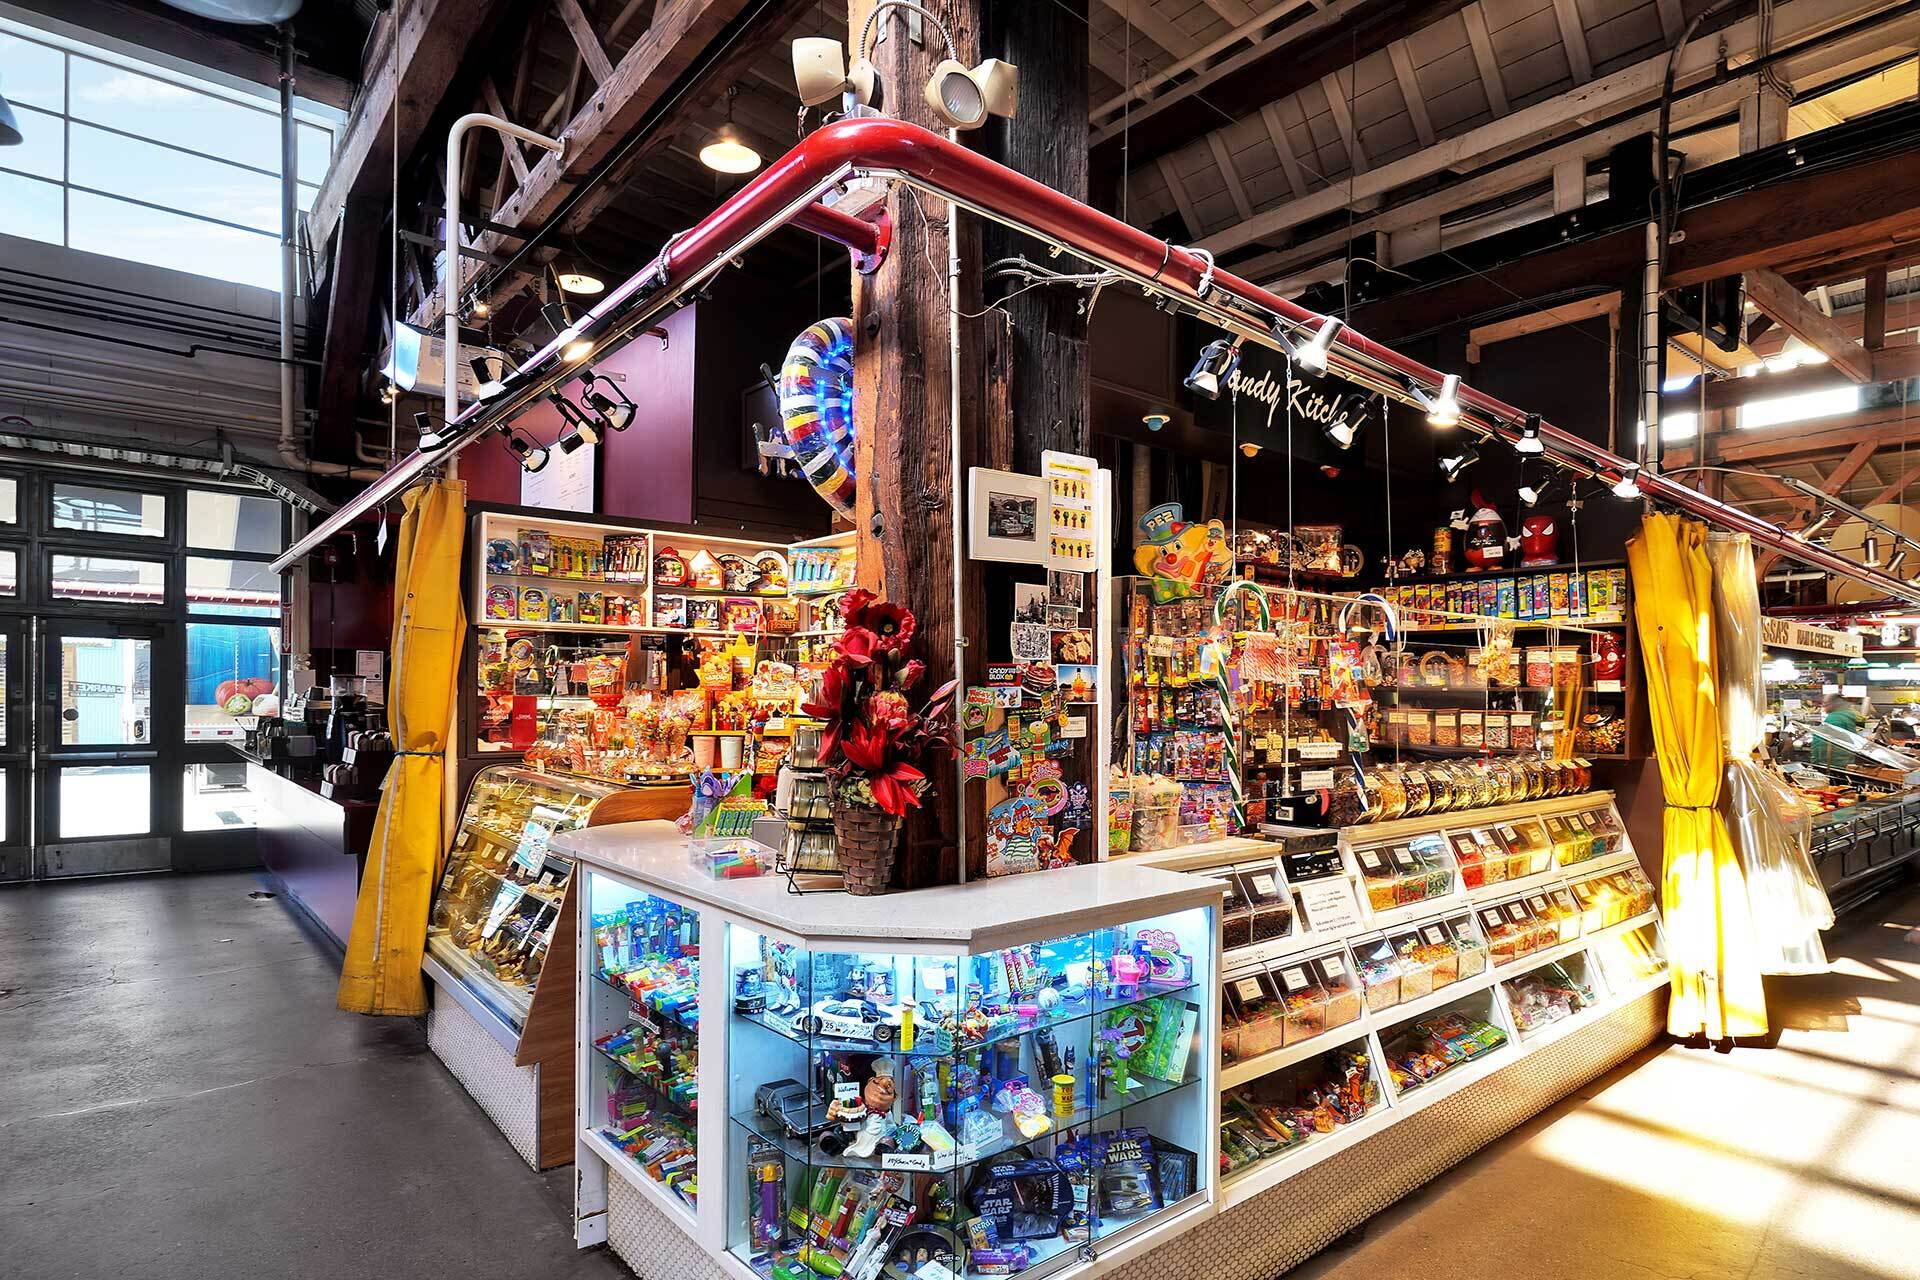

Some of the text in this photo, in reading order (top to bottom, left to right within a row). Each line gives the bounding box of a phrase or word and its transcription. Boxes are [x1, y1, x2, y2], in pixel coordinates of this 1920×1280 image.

[1218, 359, 1349, 428] andy Kitche
[1146, 510, 1175, 531] PEZ
[1815, 632, 1835, 650] CHEESE
[825, 1021, 834, 1030] 25
[1106, 1139, 1141, 1153] STAR
[1107, 1149, 1143, 1163] WARS
[980, 1198, 1013, 1209] STAR
[980, 1206, 1013, 1215] WARS
[884, 1208, 907, 1223] PEZ
